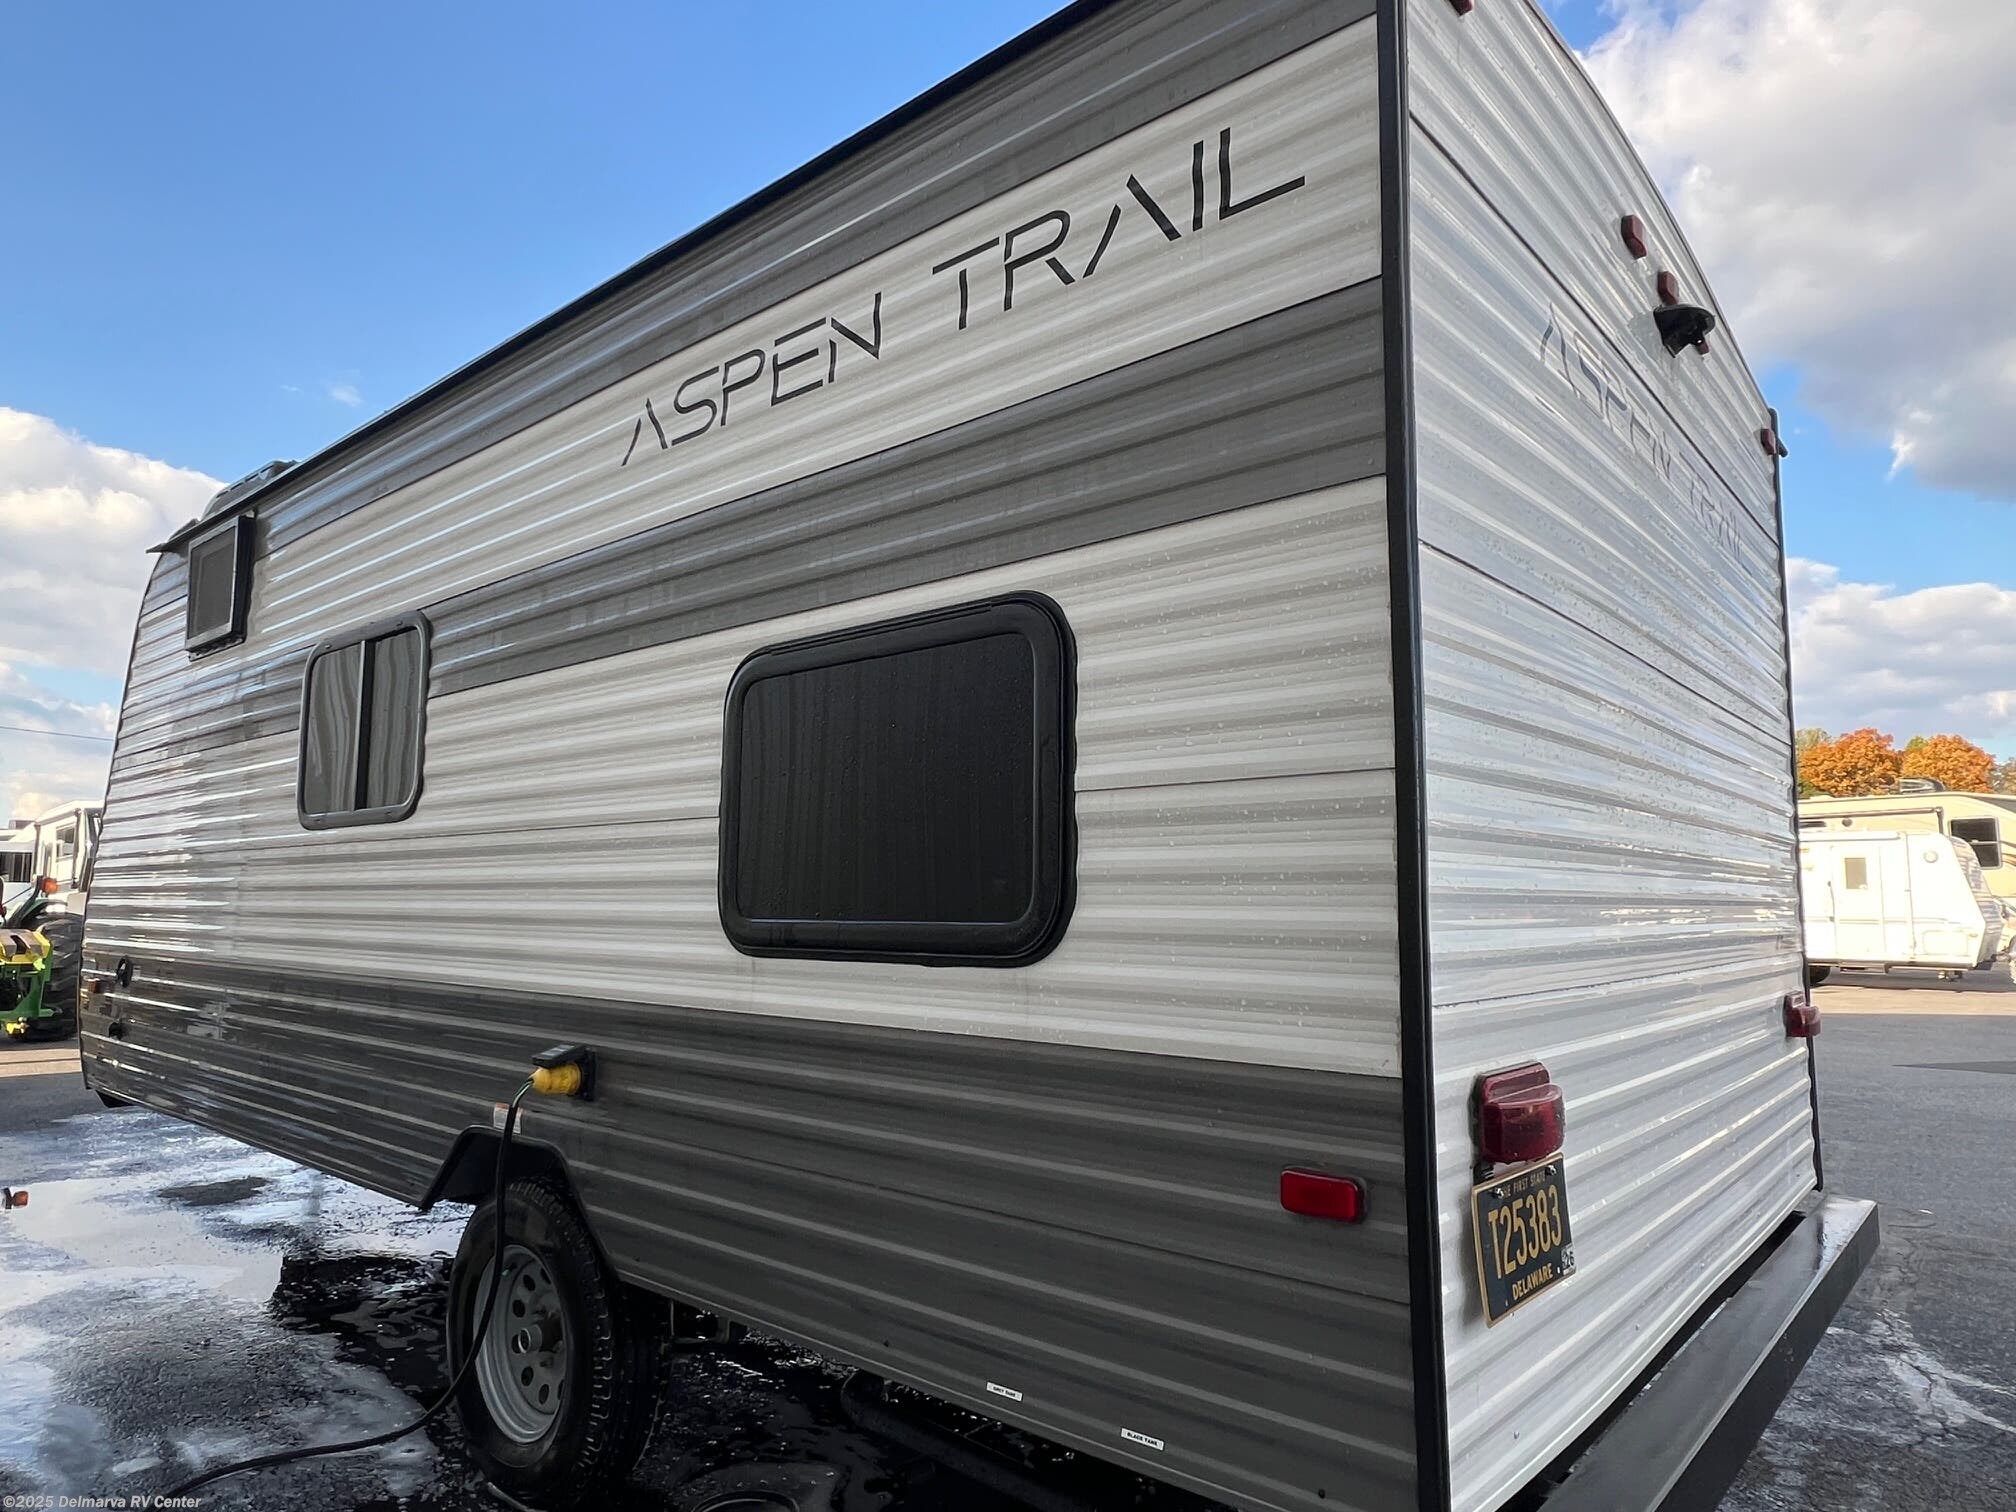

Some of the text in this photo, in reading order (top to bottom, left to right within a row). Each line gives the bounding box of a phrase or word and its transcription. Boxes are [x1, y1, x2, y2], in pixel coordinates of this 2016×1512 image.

[620, 127, 1306, 467] ASPEN TRAIL
[1539, 302, 1671, 482] ASPEN
[1487, 1184, 1562, 1281] T25383
[1513, 1176, 1528, 1193] FIRST
[1512, 1262, 1554, 1301] DELAWARE
